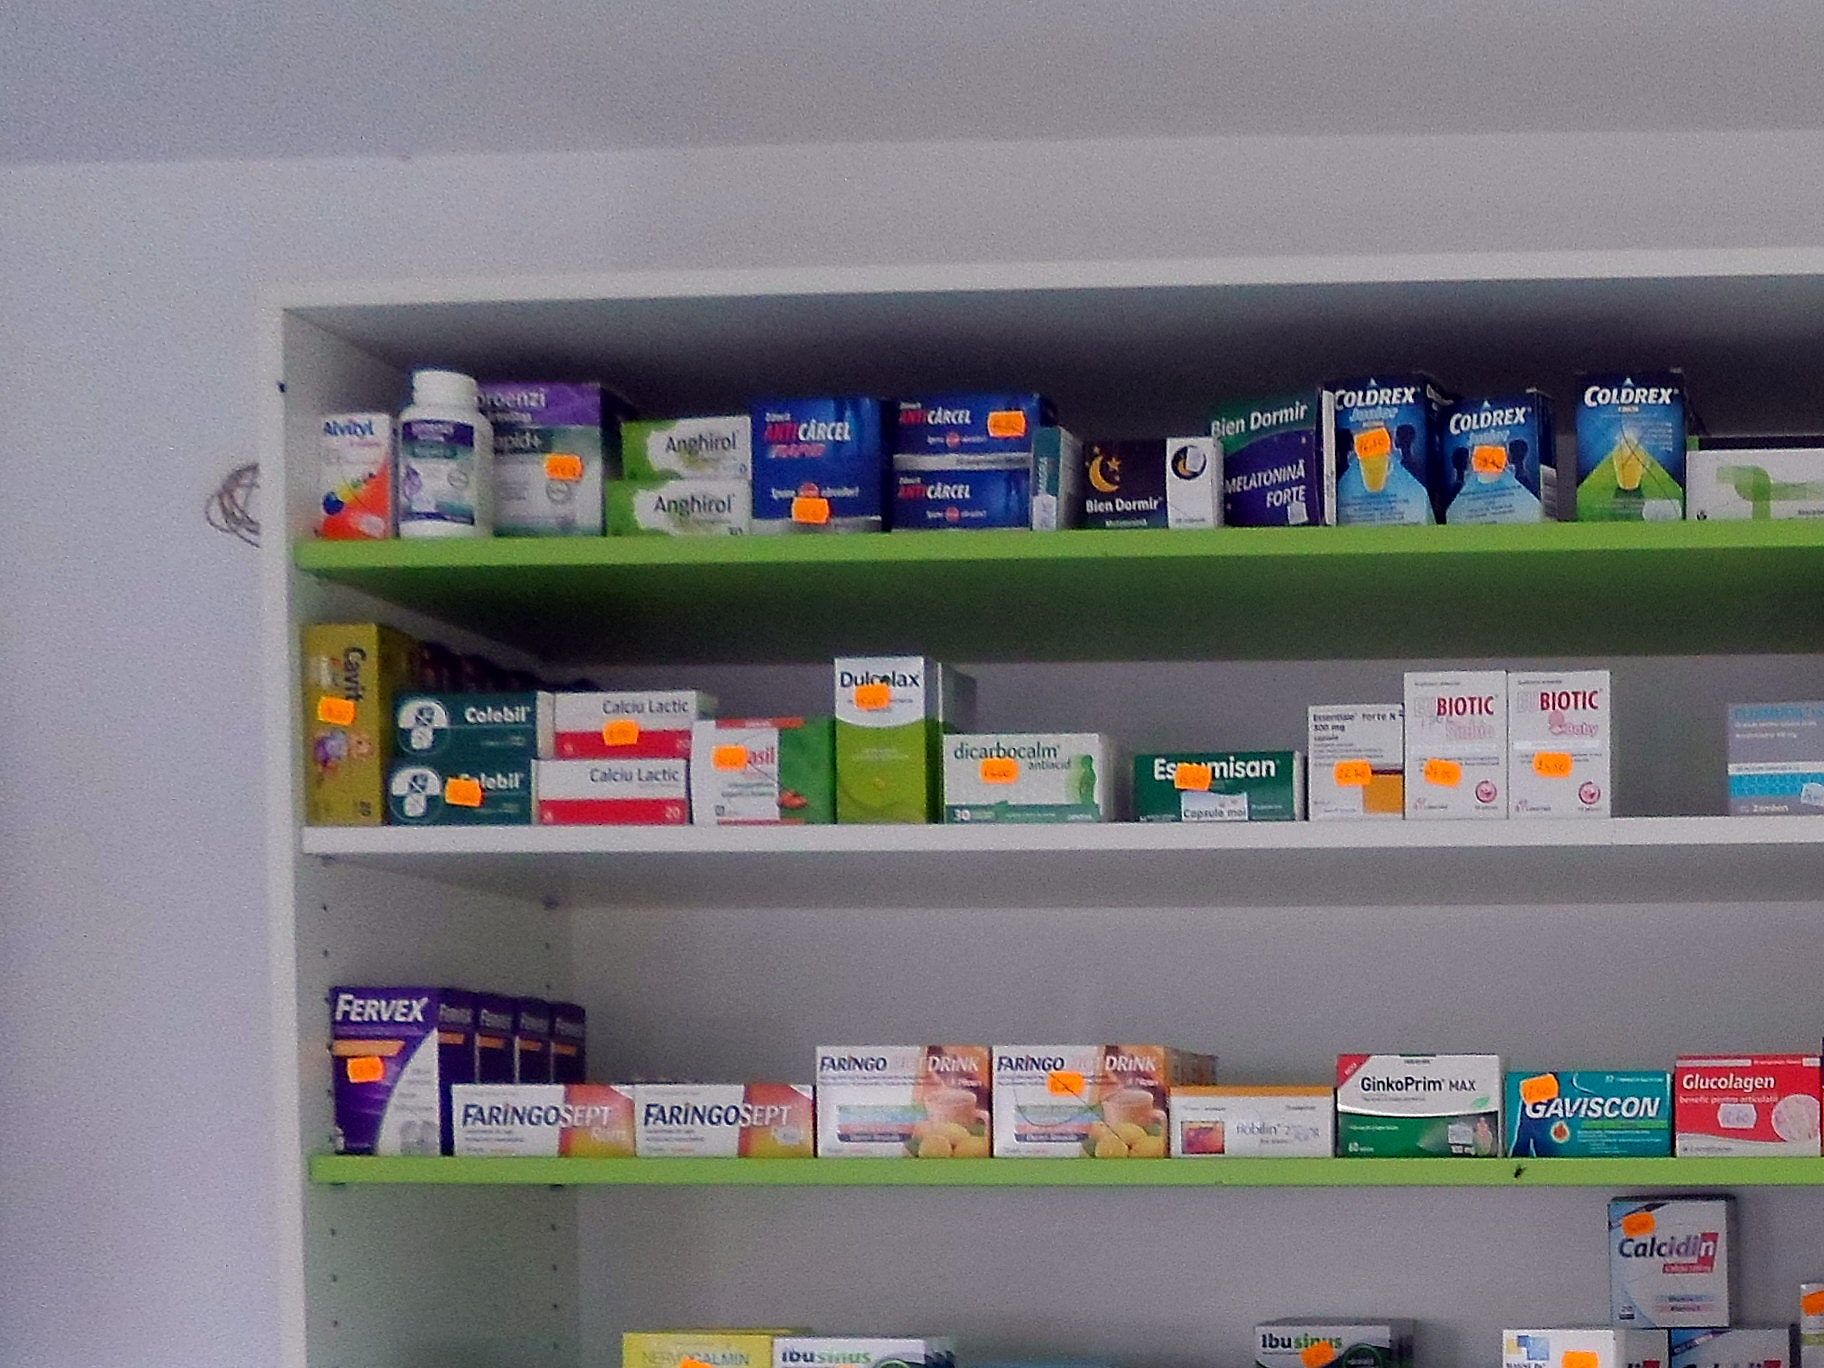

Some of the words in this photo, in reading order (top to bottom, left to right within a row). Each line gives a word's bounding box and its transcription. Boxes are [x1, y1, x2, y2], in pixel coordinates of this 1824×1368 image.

[1334, 386, 1416, 411] COLDREX
[1584, 386, 1672, 406] COLDREX
[1211, 418, 1248, 438] Bien
[1251, 403, 1308, 429] Dormir
[1449, 406, 1526, 435] COLDREX
[666, 431, 736, 454] Anghirol
[1224, 459, 1306, 495] MELATONINĂ
[654, 491, 732, 514] Anghirol
[1086, 498, 1112, 512] Bien
[1115, 497, 1159, 512] Dormir
[1266, 486, 1306, 507] FORTE
[602, 700, 645, 713] Calciu
[648, 700, 689, 713] Lactic
[954, 742, 1056, 760] dicarbocalm
[1028, 759, 1071, 770] antiacid
[590, 768, 633, 783] Calciu
[637, 768, 681, 782] Lactic
[953, 808, 970, 820] 30
[1183, 807, 1223, 818] Capsule
[335, 994, 428, 1023] FERVEX
[1361, 1076, 1443, 1093] GinkoPrim
[1449, 1079, 1476, 1092] MAX
[1682, 1075, 1774, 1093] Glucolagen
[463, 1102, 611, 1128] FARINGOSEPT
[643, 1102, 791, 1128] FARINGOSEPT
[1526, 1098, 1659, 1118] GAVISCON
[1619, 1232, 1718, 1258] Calcidin
